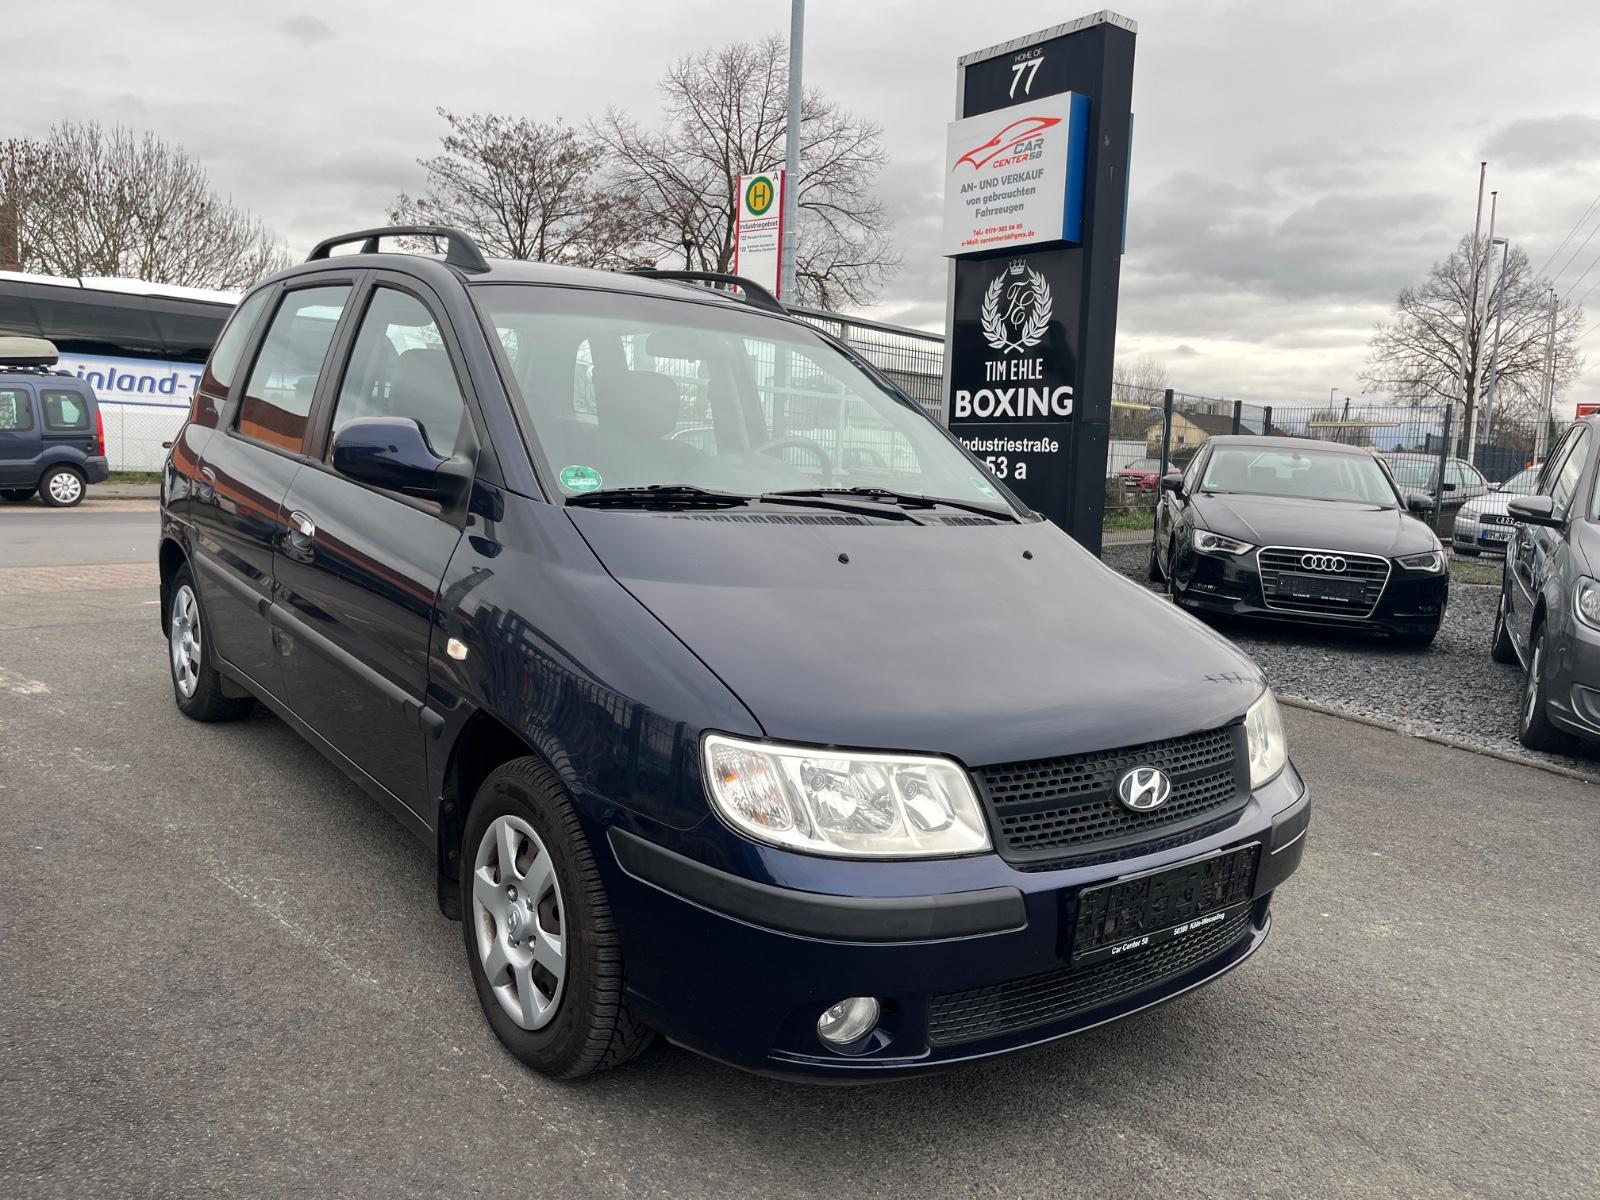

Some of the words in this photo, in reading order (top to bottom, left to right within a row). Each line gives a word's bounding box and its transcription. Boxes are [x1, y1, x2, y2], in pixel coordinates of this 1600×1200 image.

[1015, 52, 1032, 63] HOME
[1033, 47, 1043, 57] OF
[1010, 57, 1044, 99] 77
[1013, 138, 1044, 154] CAR
[773, 172, 779, 181] A
[960, 182, 977, 194] AN-
[980, 178, 999, 190] UND
[1001, 168, 1044, 186] VERKAUF
[753, 185, 765, 208] H
[966, 196, 981, 206] von
[983, 186, 1036, 205] gebrauchten
[975, 203, 1024, 218] Fahrzeugen
[739, 220, 778, 230] Industriegebiet
[985, 360, 1007, 382] TIM
[1010, 358, 1044, 381] EHLE
[955, 385, 1074, 418] BOXING
[959, 437, 1059, 453] Industriestraße
[986, 456, 1008, 479] 53
[1014, 462, 1027, 480] a
[1112, 945, 1122, 955] Car
[1123, 940, 1141, 952] Center
[1142, 936, 1149, 946] 58
